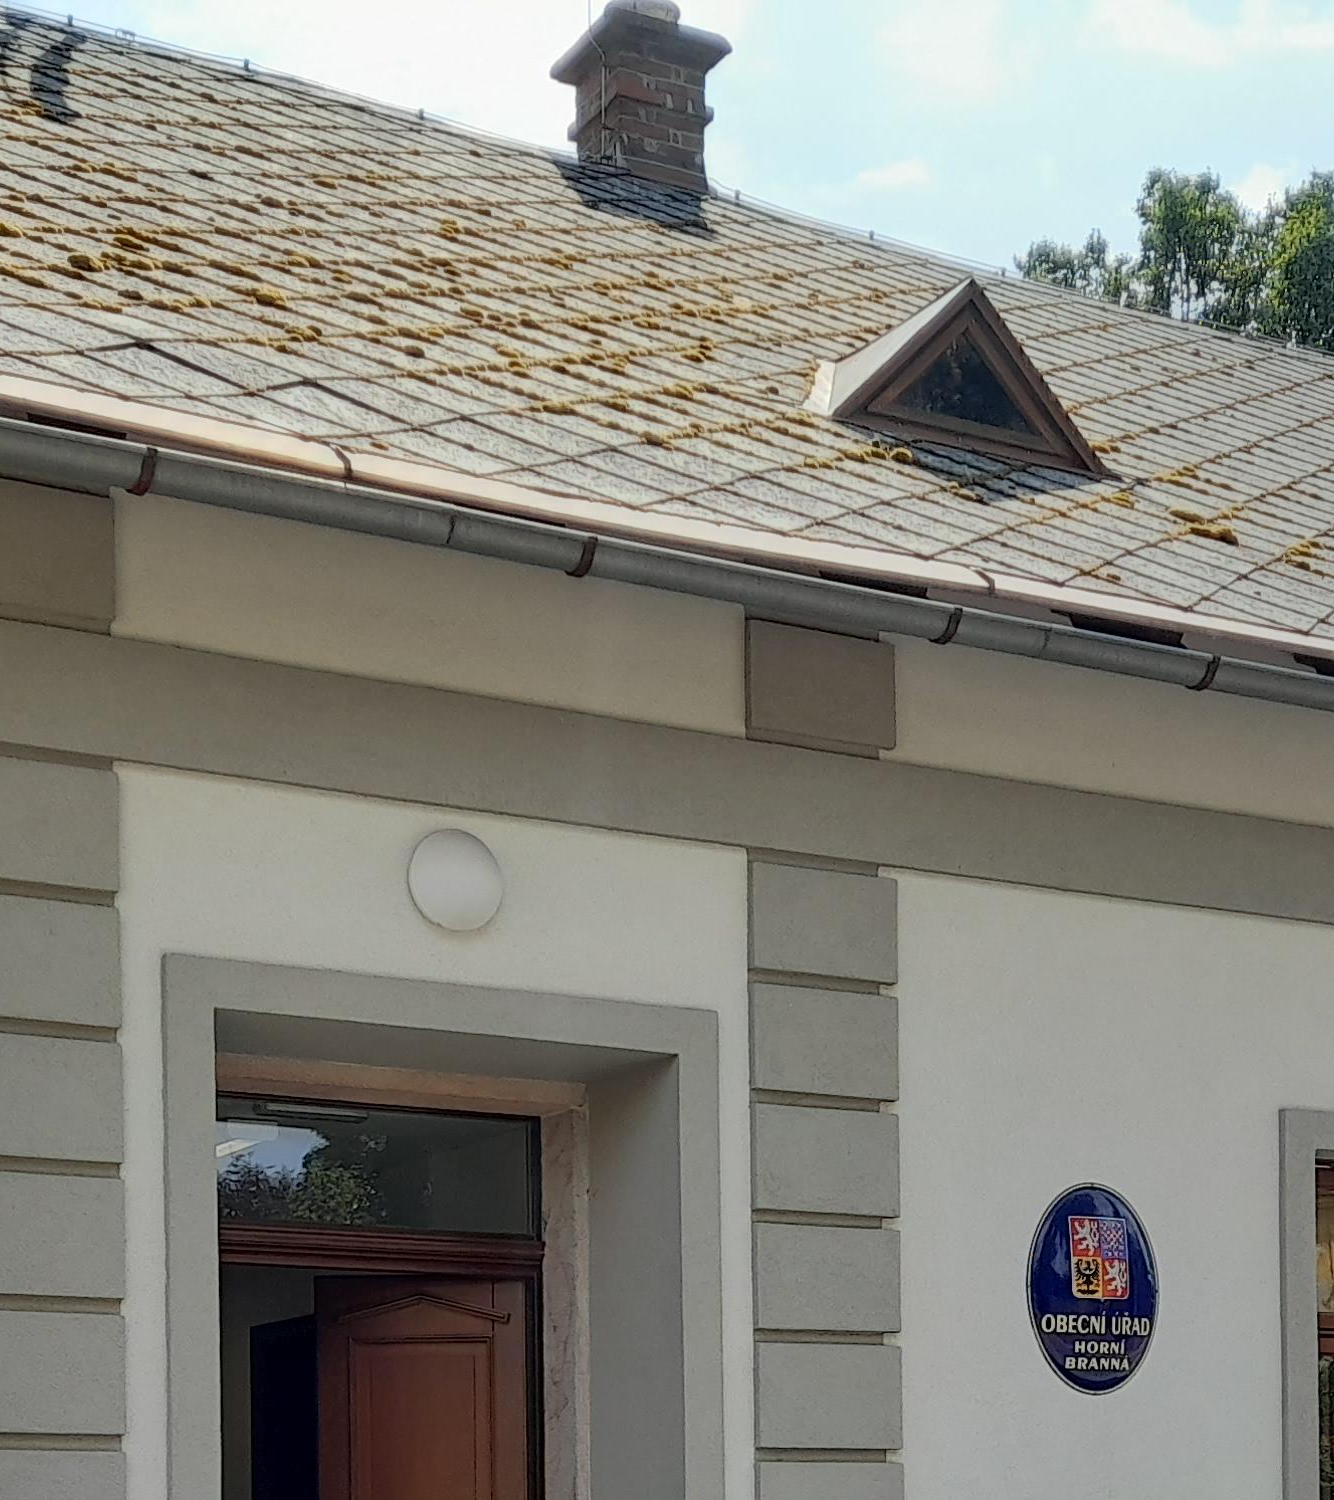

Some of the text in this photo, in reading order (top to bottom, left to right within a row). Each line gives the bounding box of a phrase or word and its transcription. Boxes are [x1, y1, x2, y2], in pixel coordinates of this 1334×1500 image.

[1041, 1311, 1150, 1336] OBECNÍ ÚŘAD
[1074, 1339, 1125, 1354] HORNÍ
[1065, 1355, 1130, 1370] BRANNÁ
